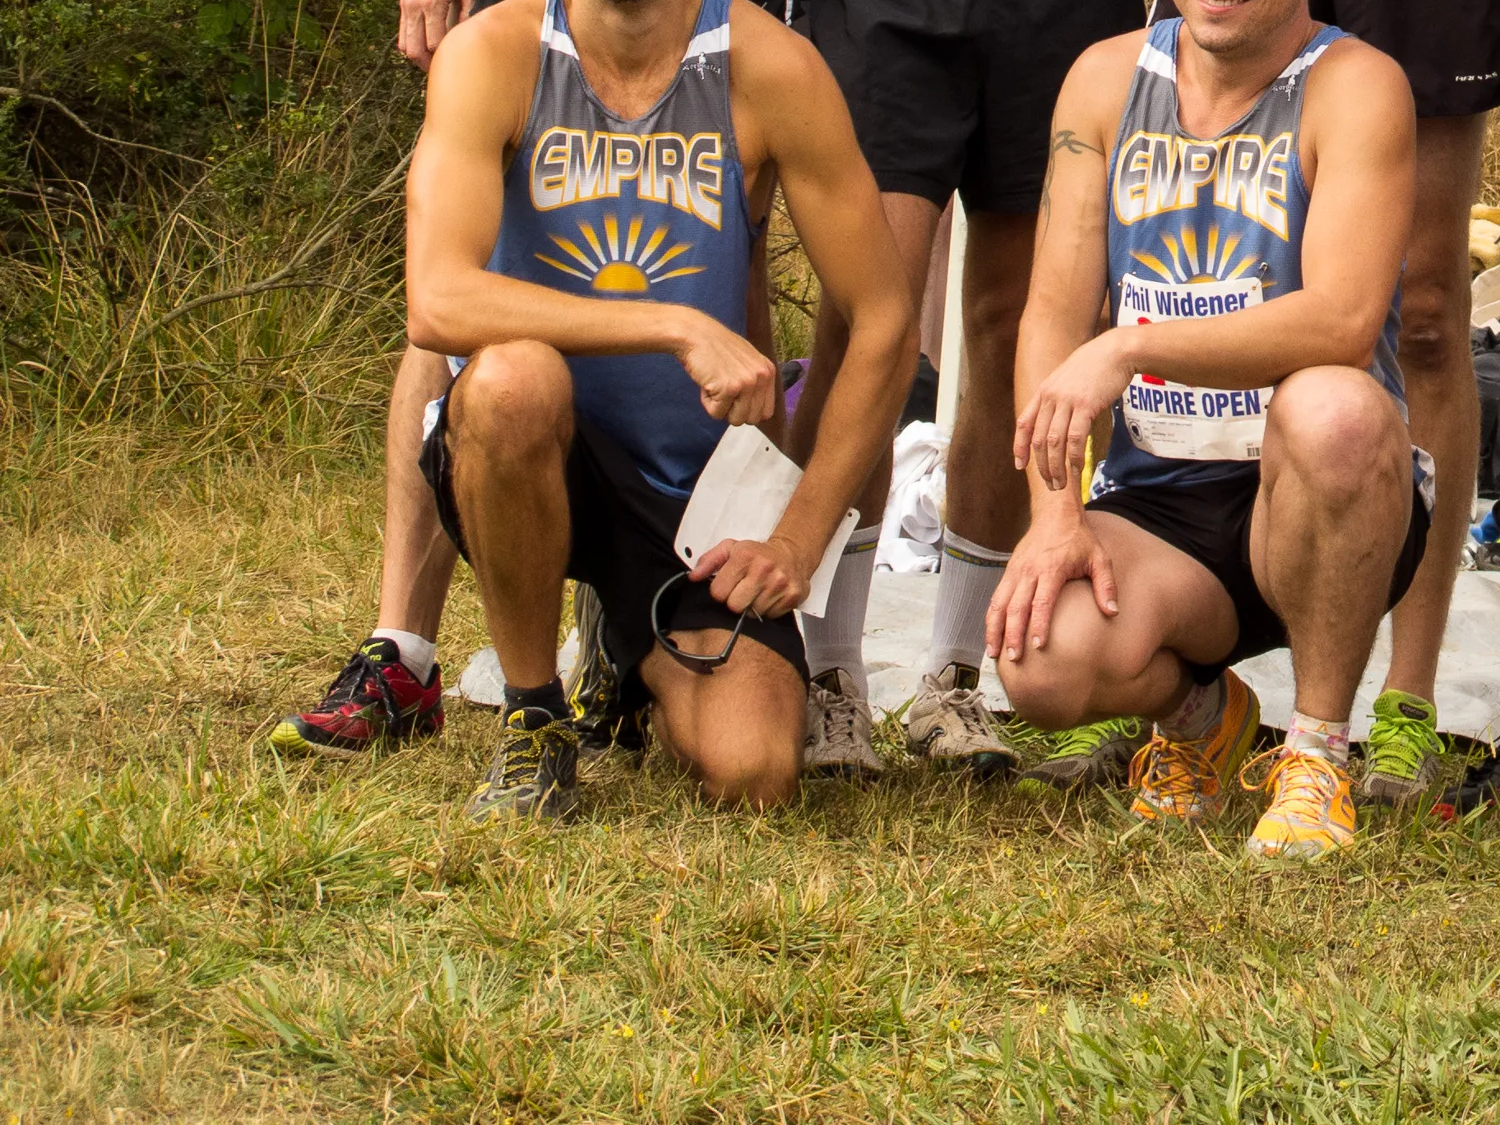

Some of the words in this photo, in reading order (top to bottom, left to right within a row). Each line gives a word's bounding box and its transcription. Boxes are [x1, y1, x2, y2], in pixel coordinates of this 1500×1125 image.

[530, 126, 724, 231] EMPIRE
[1113, 130, 1292, 241] EMPIRE
[1125, 282, 1150, 313] Phil
[1155, 290, 1249, 316] Widener
[1130, 385, 1197, 415] EMPIRE
[1202, 390, 1261, 418] OPEN
